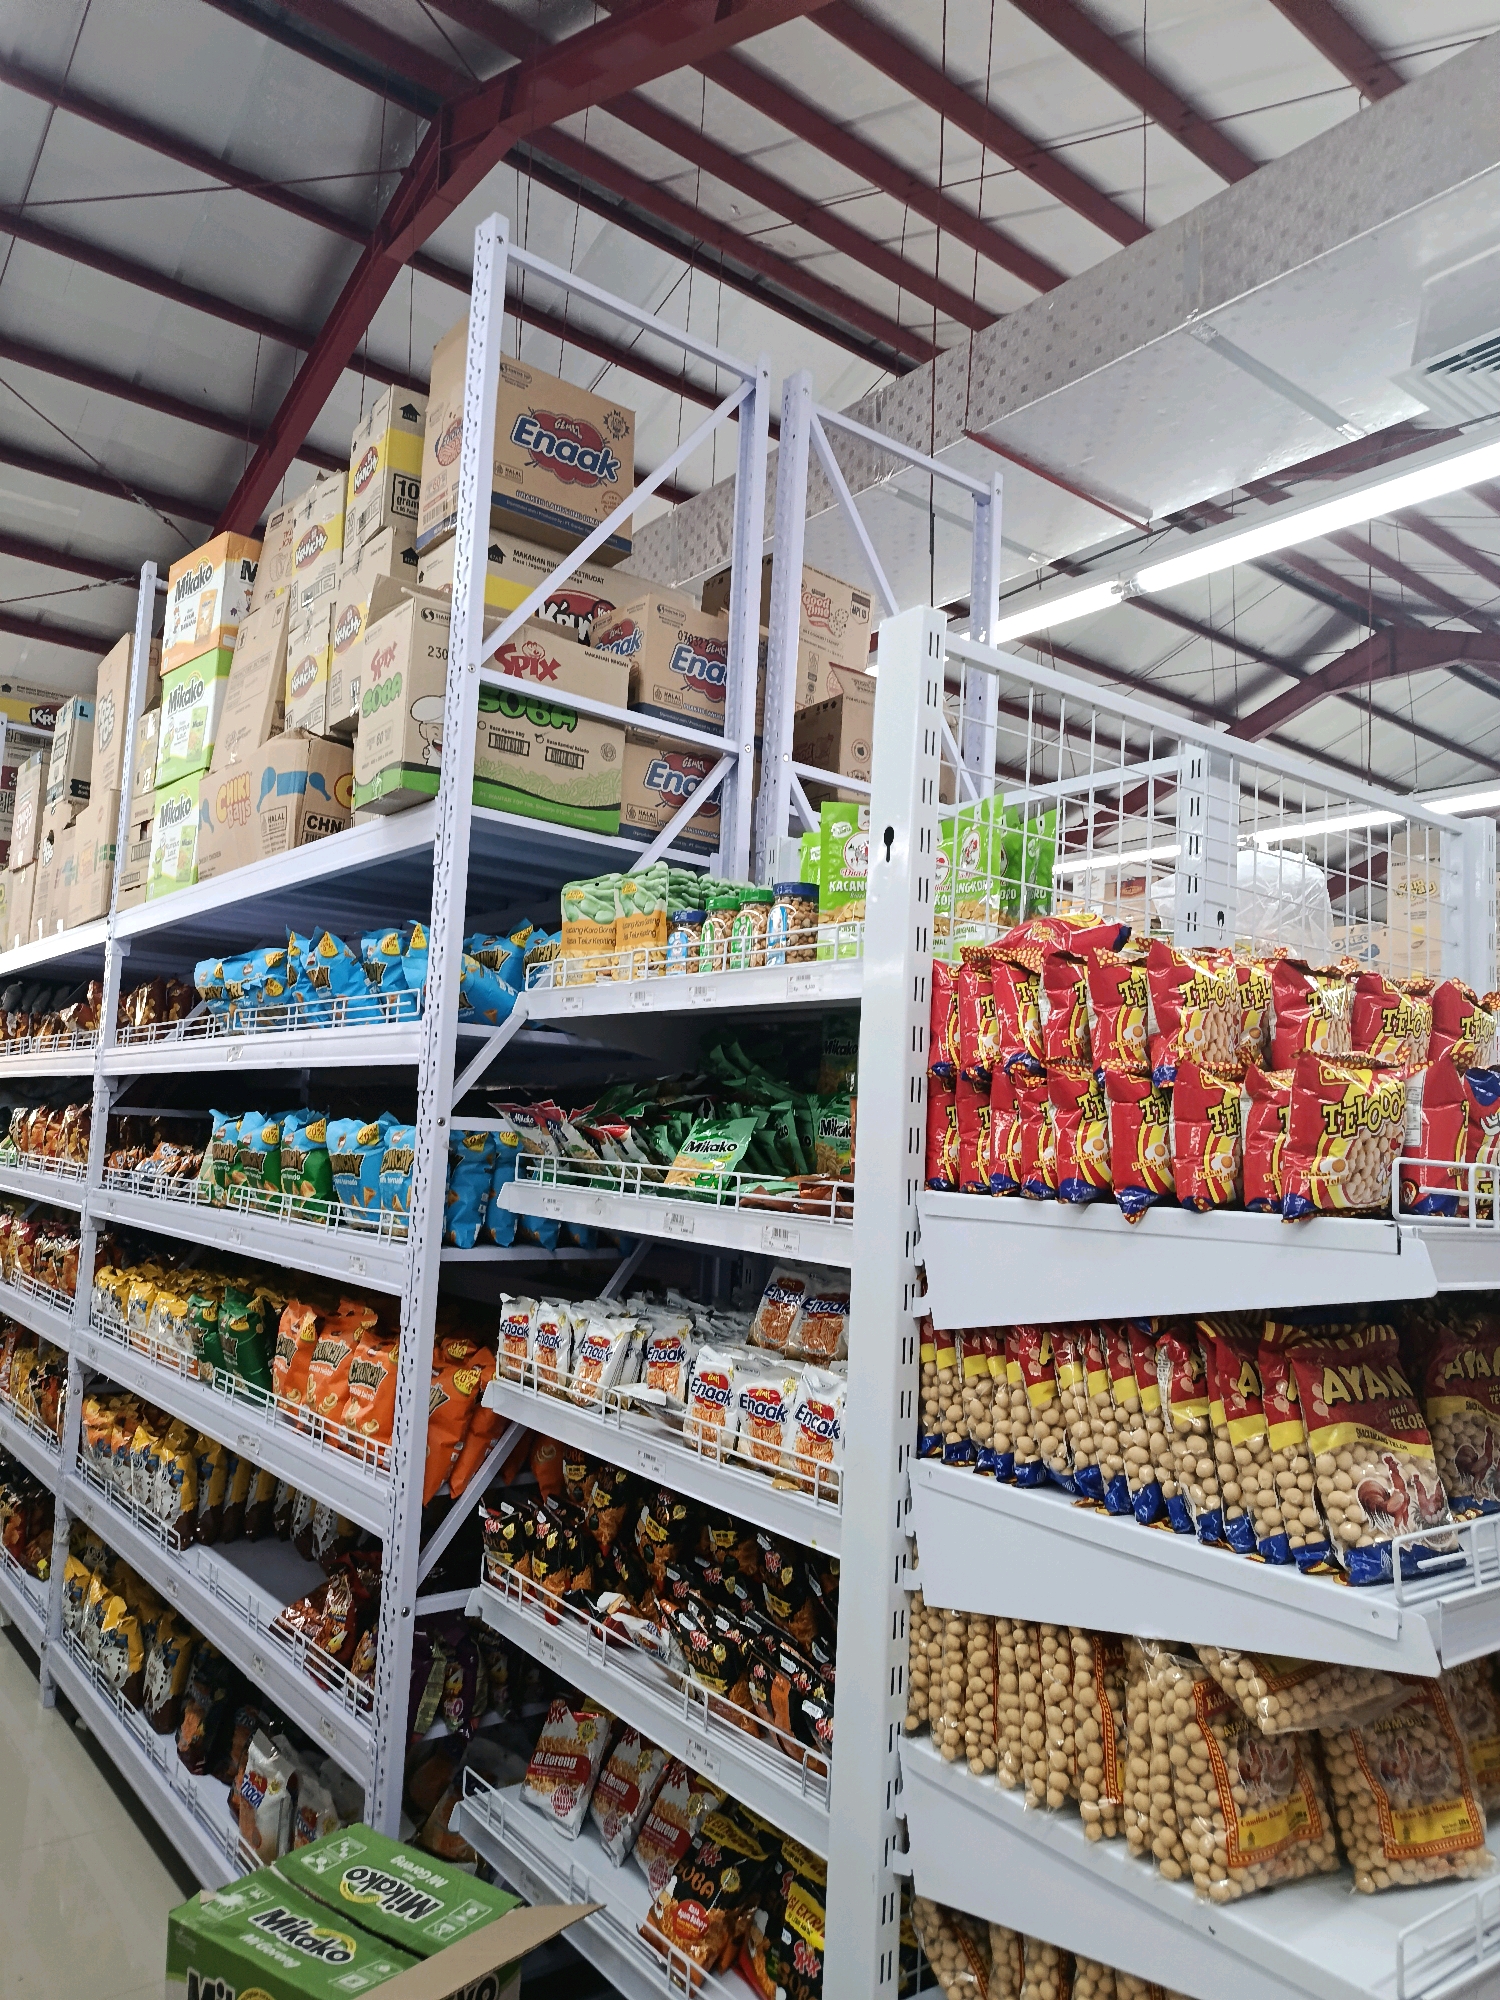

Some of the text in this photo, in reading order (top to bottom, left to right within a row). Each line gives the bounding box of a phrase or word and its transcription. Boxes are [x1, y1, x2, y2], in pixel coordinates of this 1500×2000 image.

[512, 416, 620, 482] Enaak
[513, 549, 546, 565] MAKANAN
[174, 564, 213, 604] Mikako
[168, 679, 204, 715] Mikako
[362, 672, 402, 718] SOBA
[216, 771, 251, 823] CHIKI
[159, 797, 192, 829] Mikako
[268, 814, 285, 823] HALAL
[683, 1140, 738, 1154] Mikako
[500, 1319, 530, 1337] Enaak
[535, 1330, 562, 1349] Enaak
[581, 1341, 612, 1362] Enaak
[647, 1346, 687, 1362] Enaak
[691, 1378, 734, 1407] Enaak
[1322, 1362, 1414, 1405] AYAM
[739, 1393, 789, 1424] Enaak
[795, 1403, 840, 1440] Enaak
[1391, 1412, 1426, 1430] TELOR
[607, 1774, 630, 1795] Goreng
[653, 1816, 679, 1842] Goreng
[345, 1867, 443, 1922] Mikako
[251, 1907, 353, 1963] Mikako
